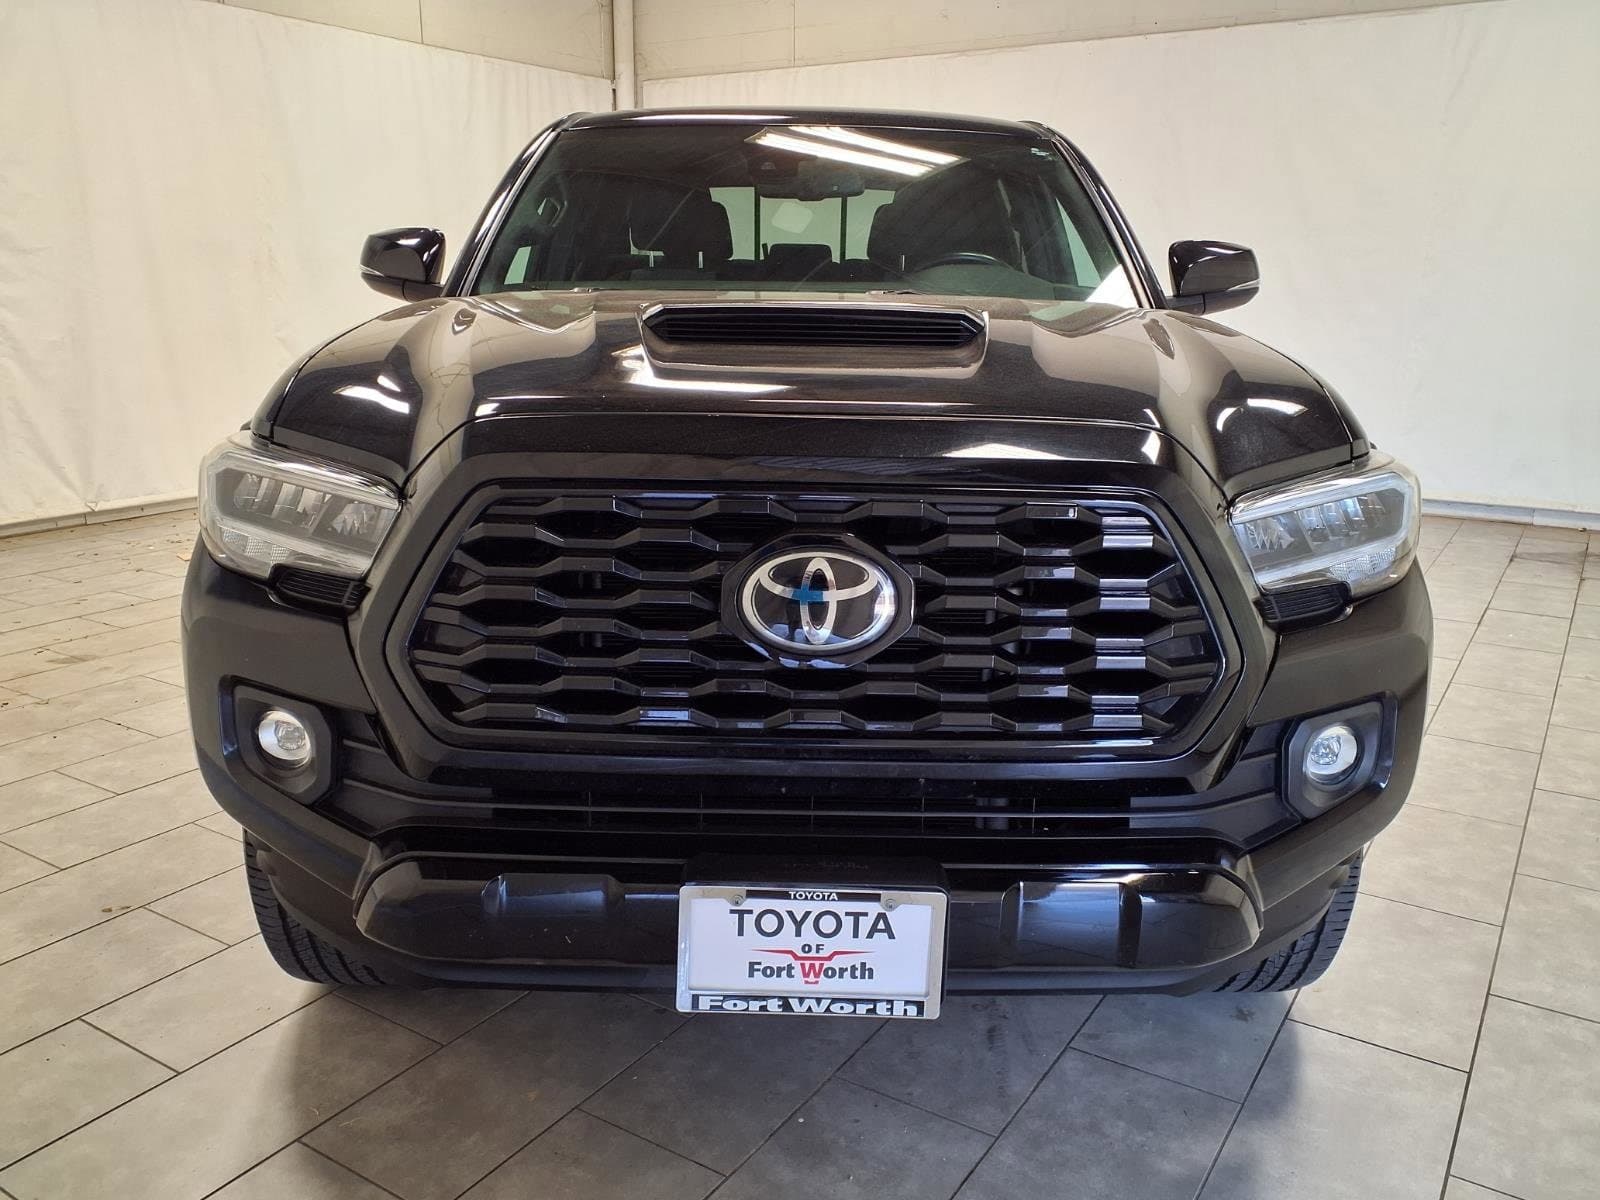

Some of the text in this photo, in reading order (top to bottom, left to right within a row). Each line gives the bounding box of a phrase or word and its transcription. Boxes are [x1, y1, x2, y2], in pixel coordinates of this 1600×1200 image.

[788, 891, 838, 901] TOYOTA
[729, 908, 896, 940] TOYOTA
[801, 943, 825, 954] OF
[748, 961, 874, 980] Fort Worth
[698, 995, 918, 1017] Fort Worth
